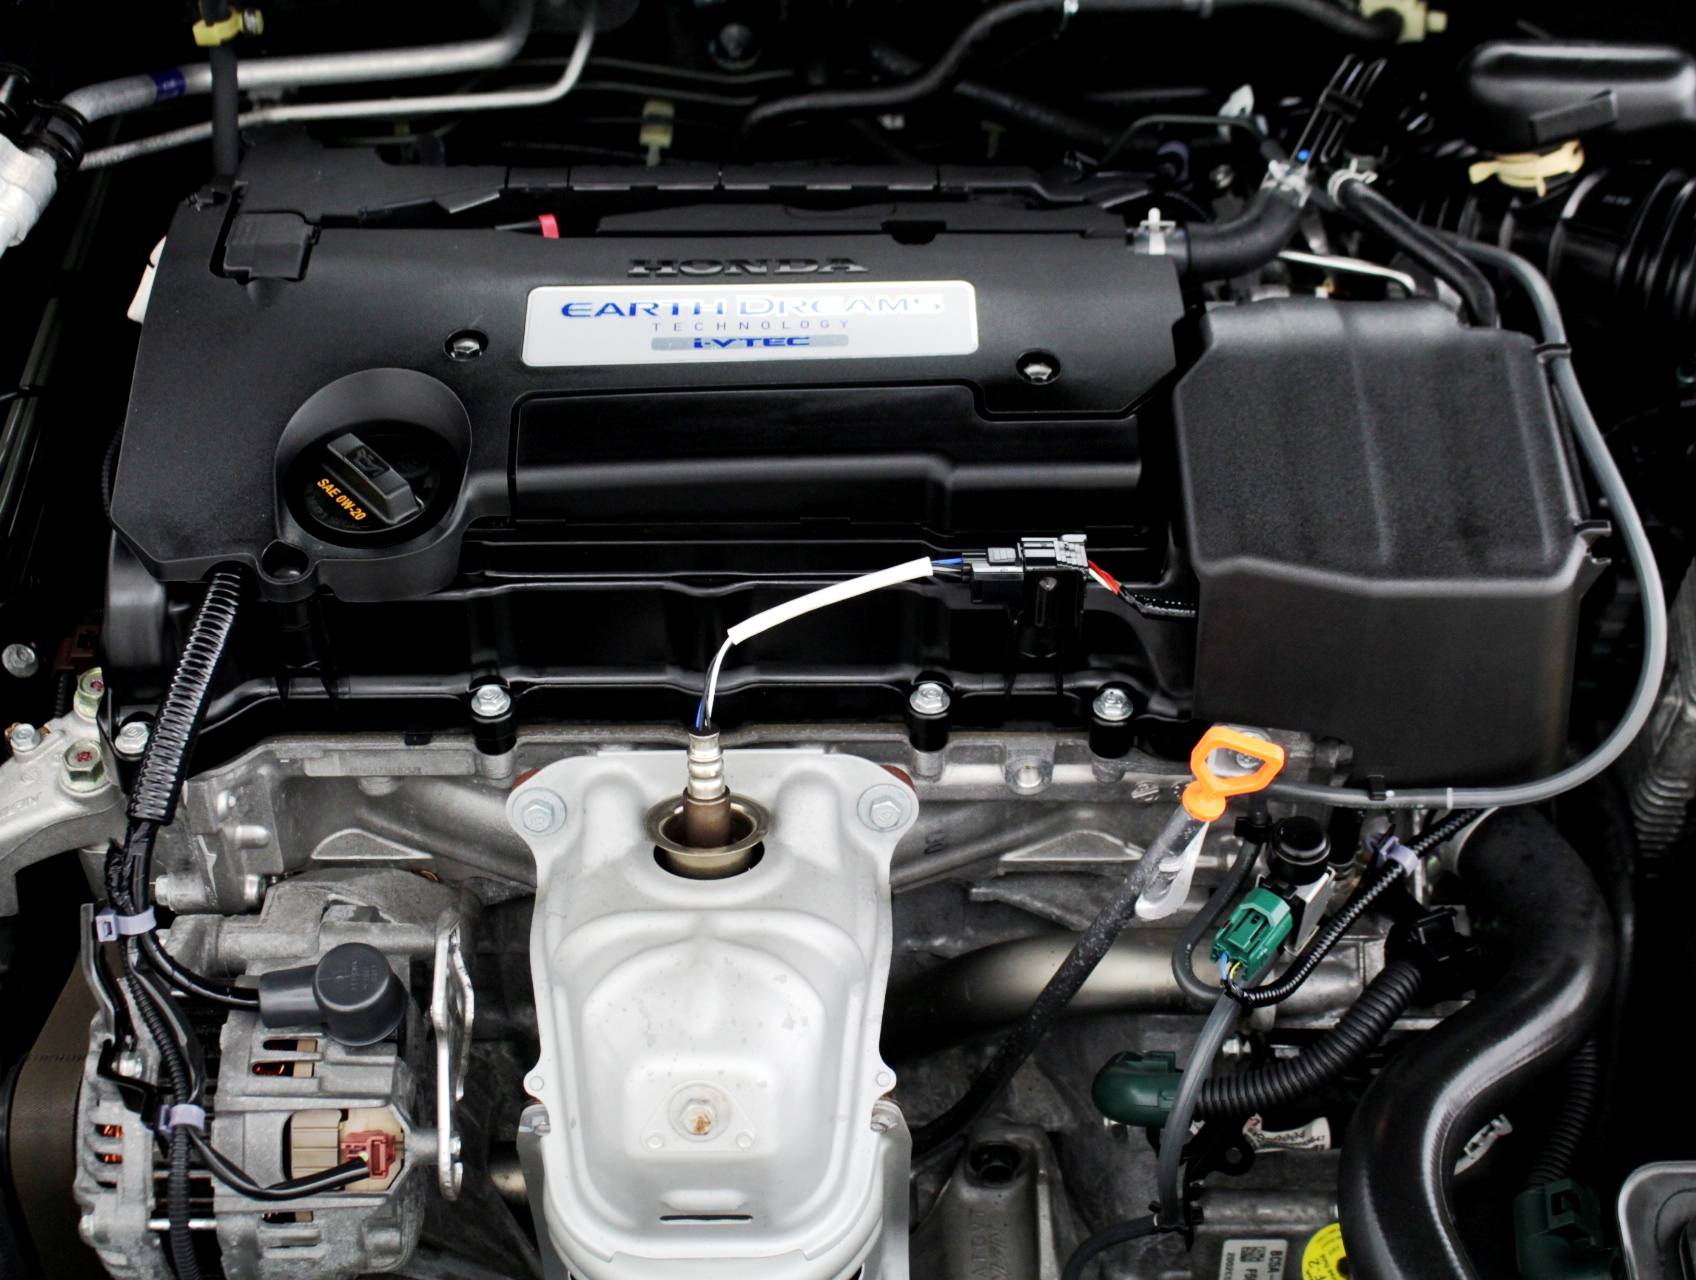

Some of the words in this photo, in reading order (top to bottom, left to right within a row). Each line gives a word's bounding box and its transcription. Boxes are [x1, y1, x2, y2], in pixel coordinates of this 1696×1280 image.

[627, 257, 869, 278] HONDA
[561, 300, 724, 318] EARTH
[651, 319, 850, 332] TECHNOLOGY
[317, 478, 341, 497] SAE
[336, 495, 367, 520] 0W-20
